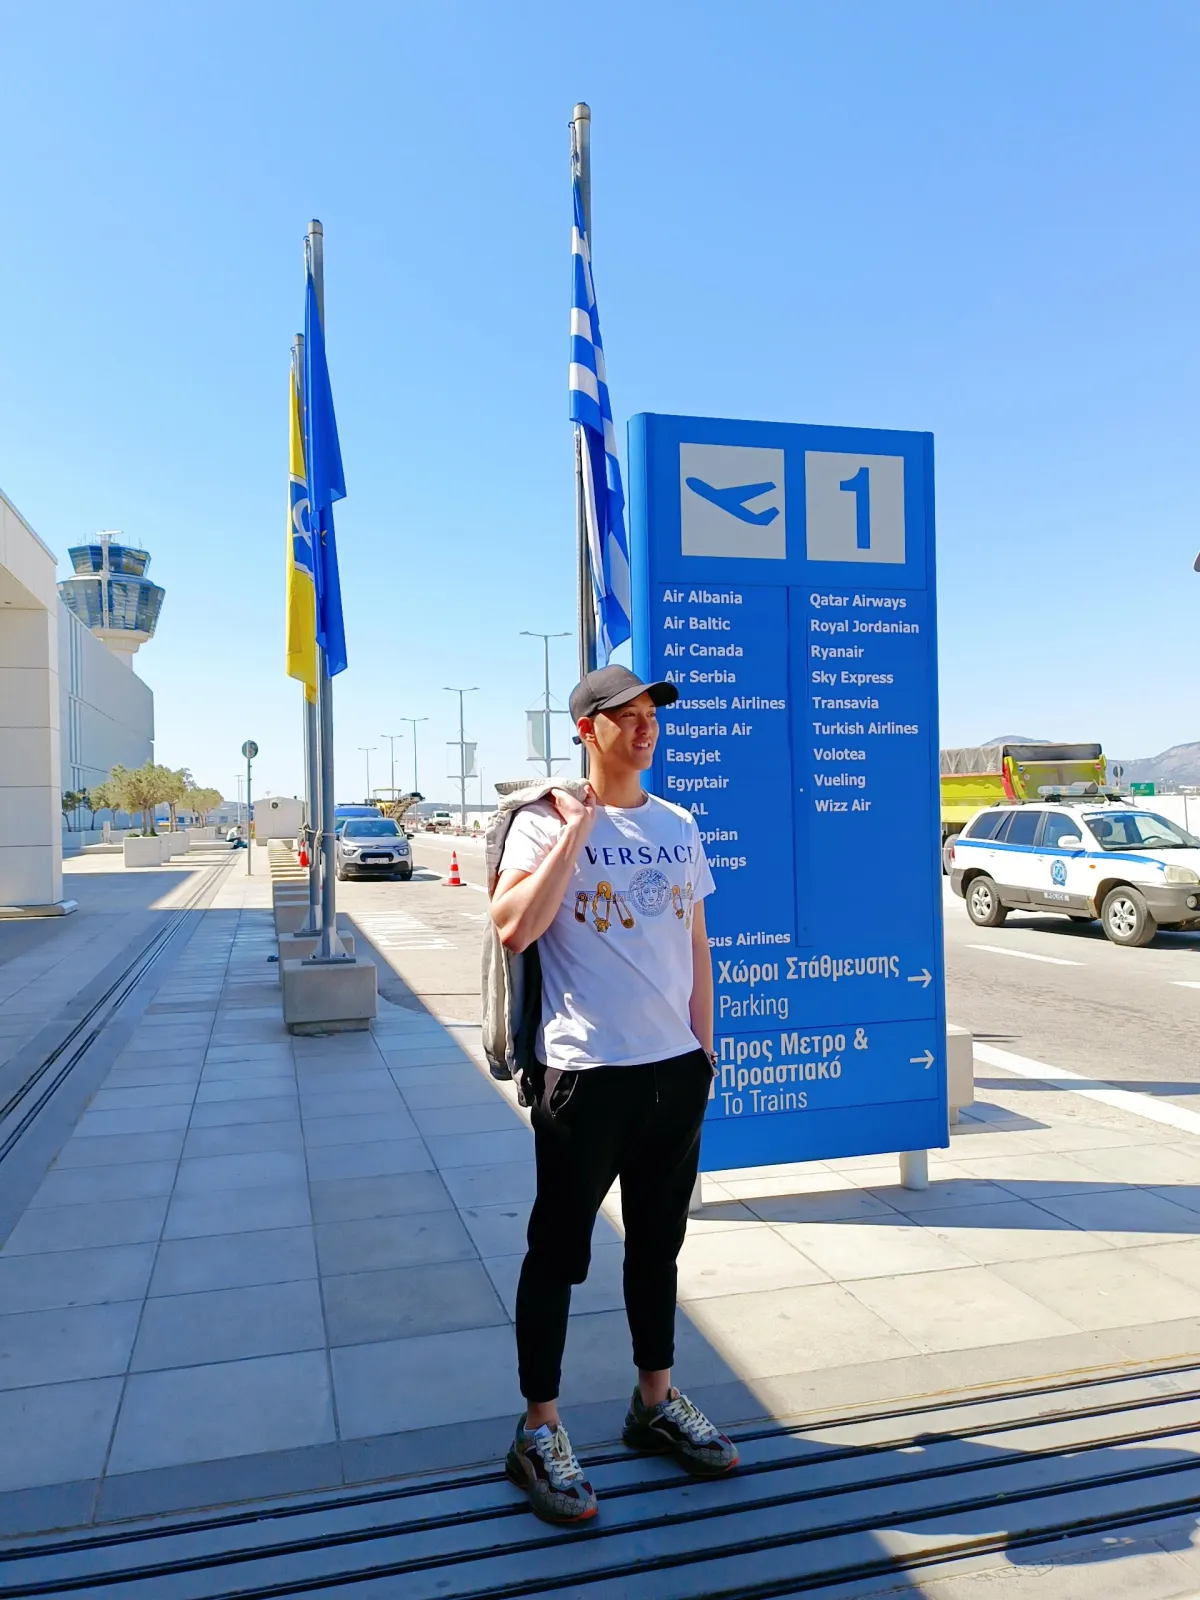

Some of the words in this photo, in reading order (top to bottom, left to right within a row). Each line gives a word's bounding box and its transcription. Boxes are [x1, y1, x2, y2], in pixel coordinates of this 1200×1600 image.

[839, 467, 871, 549] 1
[662, 589, 685, 603] Air
[688, 590, 743, 604] Albania
[809, 593, 849, 608] Qatar
[852, 594, 907, 610] Airways
[663, 616, 685, 630] Air
[689, 616, 731, 631] Baltic
[810, 618, 849, 635] Royal
[852, 620, 920, 634] Jordanian
[663, 643, 686, 657] Air
[689, 643, 744, 657] Canada
[810, 644, 864, 659] Ryanair
[664, 670, 686, 683] Air
[689, 670, 736, 683] Serbia
[811, 670, 837, 686] Sky
[841, 671, 894, 687] Express
[731, 696, 786, 710] Airlines
[812, 696, 879, 710] Transavia
[665, 723, 727, 739] Bulgaria
[731, 722, 752, 736] Air
[813, 722, 864, 735] Turkish
[868, 721, 919, 735] Airlines
[666, 749, 721, 765] Easyjet
[813, 748, 866, 761] Volotea
[667, 775, 729, 791] Egyptair
[814, 773, 866, 788] Vueling
[815, 800, 848, 812] Wizz
[851, 799, 871, 812] Air
[736, 931, 791, 946] Airlines
[718, 959, 778, 987] Χώροι
[785, 954, 900, 982] Στάθμευσης
[719, 994, 789, 1020] Parking
[720, 1037, 773, 1065] Προς
[780, 1033, 846, 1058] Μετρο
[853, 1027, 868, 1050] &
[720, 1055, 842, 1092] Προαστιακό
[720, 1092, 744, 1116] To
[749, 1088, 808, 1114] Trains
